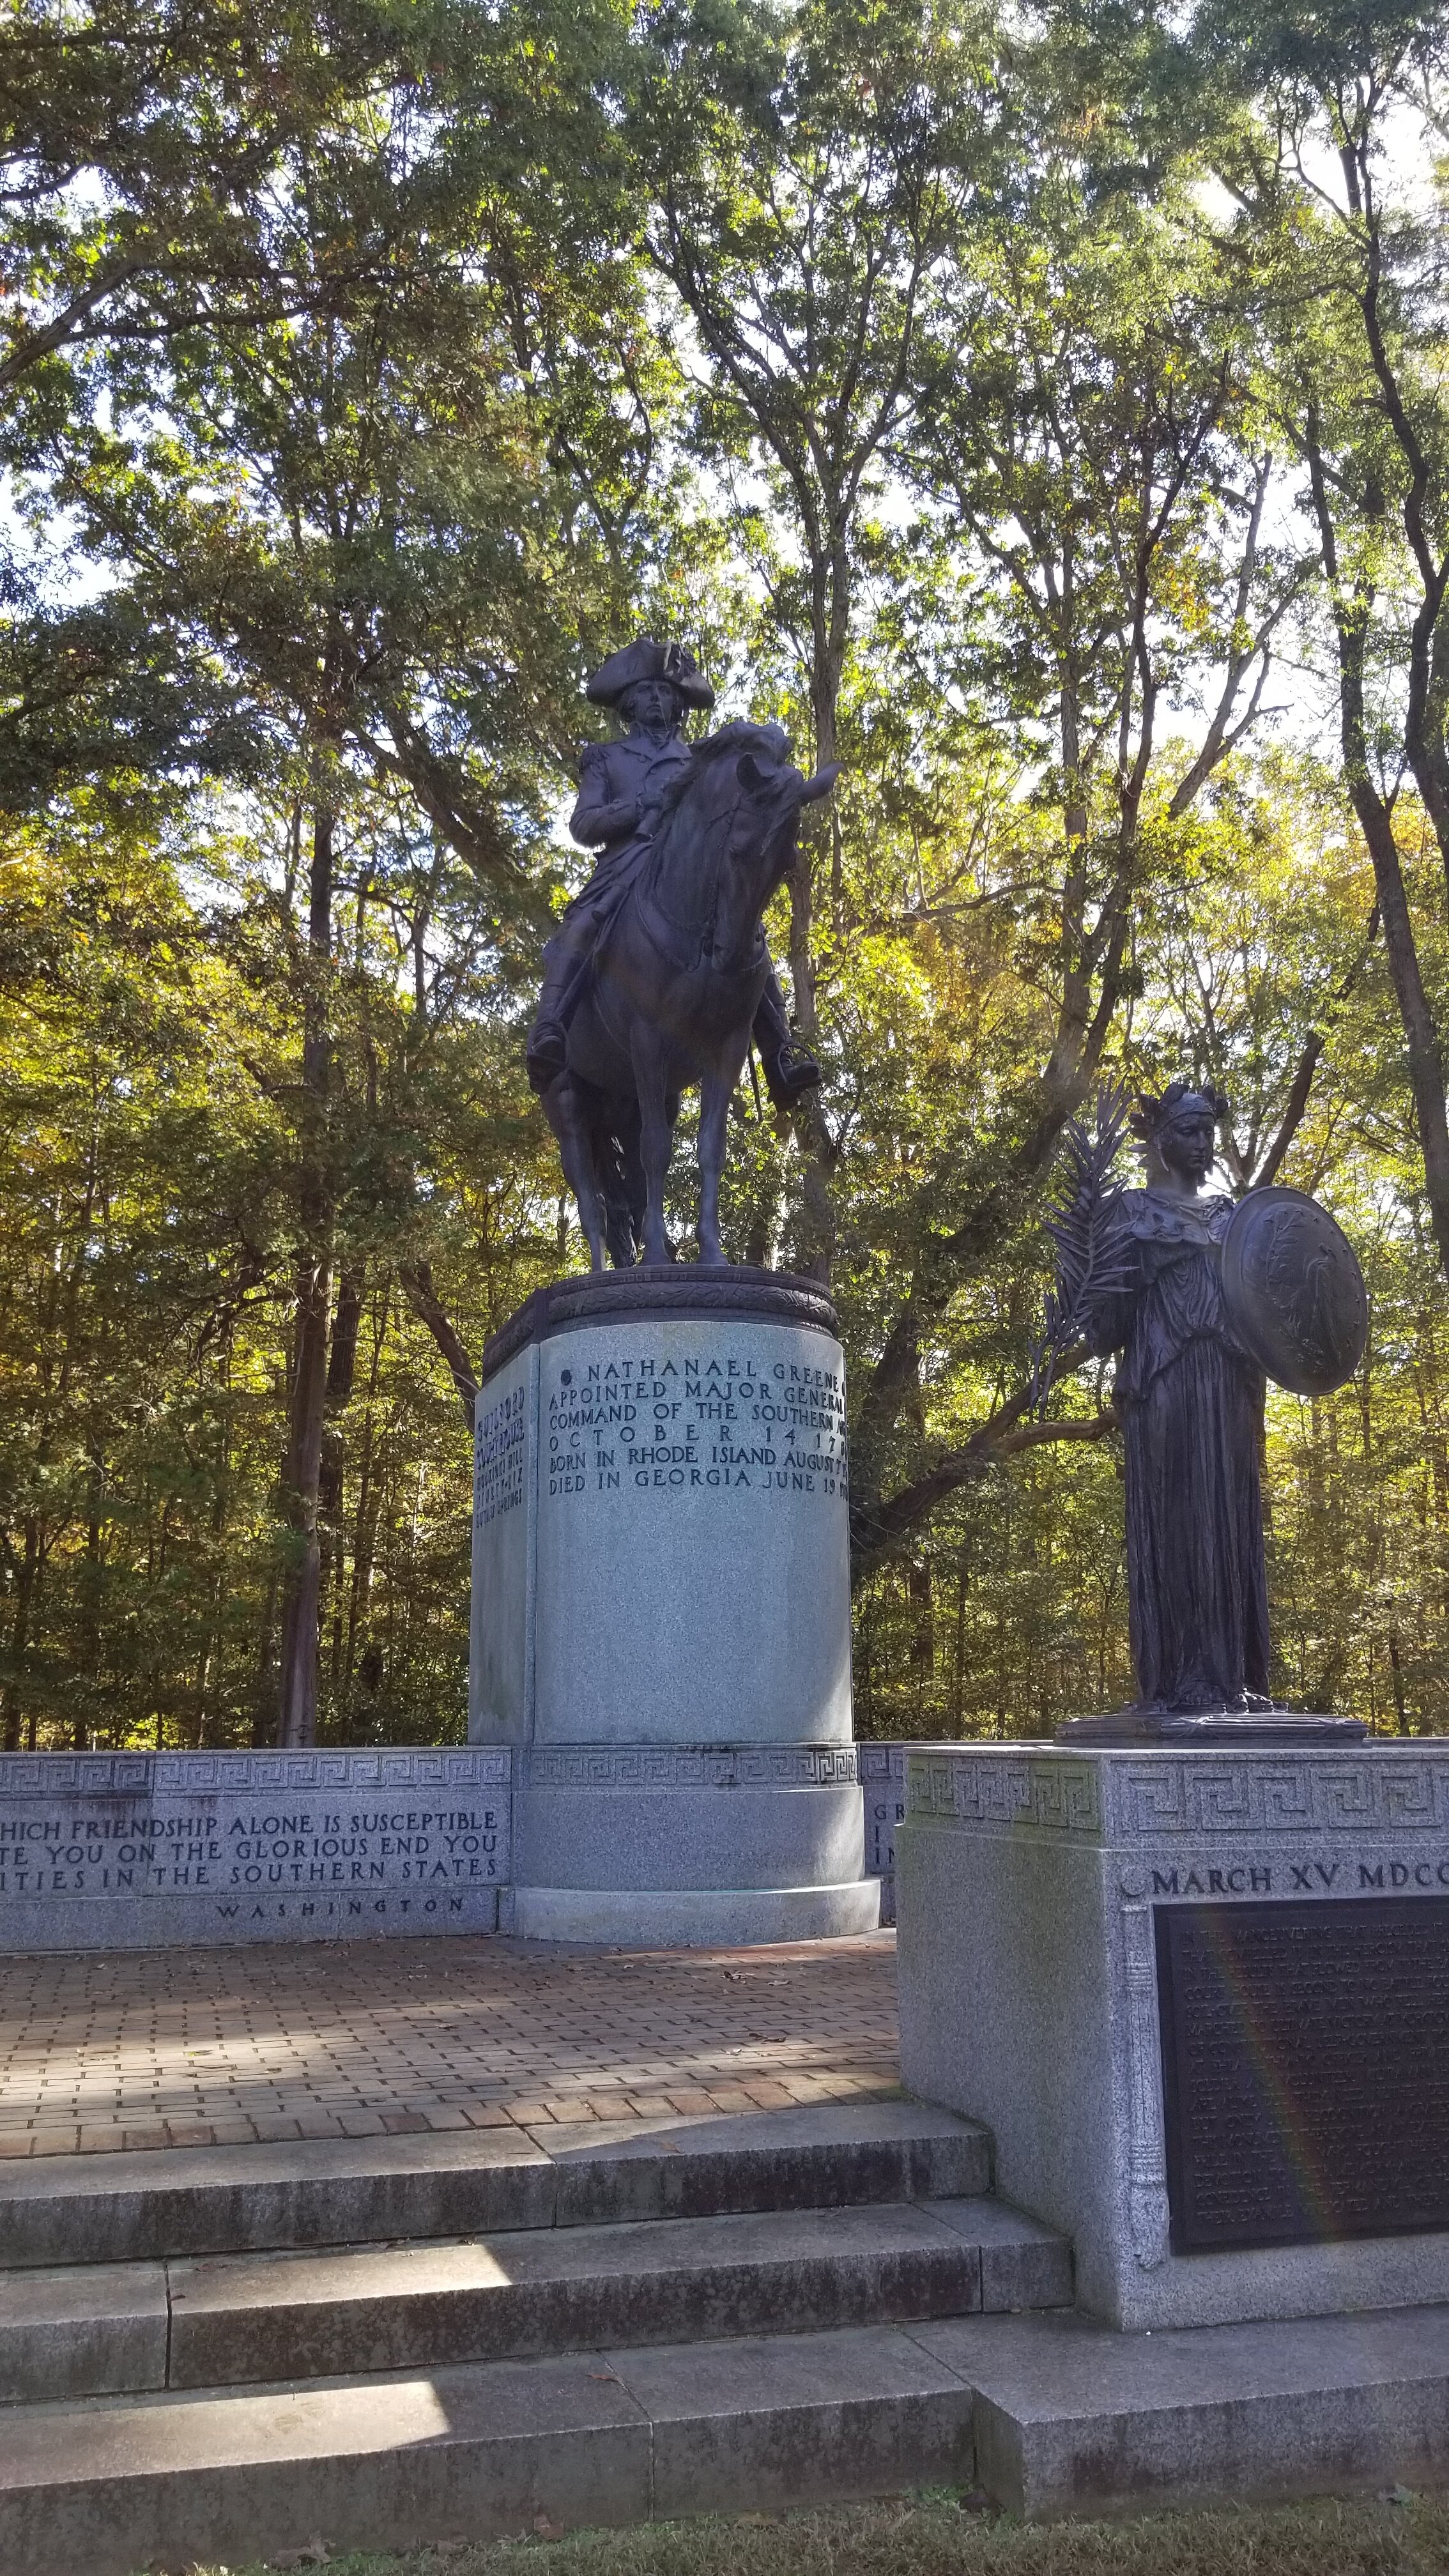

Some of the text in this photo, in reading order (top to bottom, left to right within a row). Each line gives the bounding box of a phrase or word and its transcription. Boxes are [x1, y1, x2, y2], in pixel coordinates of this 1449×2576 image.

[588, 1359, 756, 1381] NATHANAEL
[773, 1363, 839, 1393] GREENE
[549, 1382, 666, 1411] APPOINTED
[685, 1381, 772, 1400] MAJOR
[784, 1386, 843, 1414] GENERAL
[550, 1405, 637, 1430] COMMAND
[654, 1402, 682, 1419] OF
[696, 1402, 737, 1419] THE
[752, 1404, 833, 1430] SOUTHERN
[549, 1424, 733, 1452] OCTOBER
[766, 1426, 796, 1445] 14
[550, 1452, 586, 1473] BORN
[597, 1450, 615, 1467] IN
[629, 1446, 698, 1464] RHODE
[712, 1446, 776, 1465] ISLAND
[783, 1450, 834, 1473] AUGUST
[549, 1475, 586, 1495] DIED
[599, 1471, 620, 1489] IN
[635, 1468, 751, 1486] GEORGIA
[762, 1471, 815, 1491] JUNE
[824, 1477, 835, 1494] 19
[72, 1818, 217, 1839] FRIENDSHIP
[227, 1815, 313, 1835] ALONE
[324, 1815, 340, 1832] IS
[351, 1812, 497, 1832] SUSCEPTIBLE
[45, 1844, 103, 1864] YOU
[118, 1844, 156, 1862] ON
[171, 1841, 222, 1860] THE
[236, 1839, 367, 1859] GLORIOUS
[381, 1836, 429, 1855] END
[443, 1836, 496, 1853] YOU
[103, 1869, 133, 1888] IN
[153, 1866, 209, 1885] THE
[231, 1862, 384, 1884] SOUTHERN
[402, 1859, 495, 1879] STATES
[1151, 1867, 1271, 1894] MARCH
[1290, 1863, 1340, 1890] XV
[217, 1898, 463, 1917] WASHINGTON
